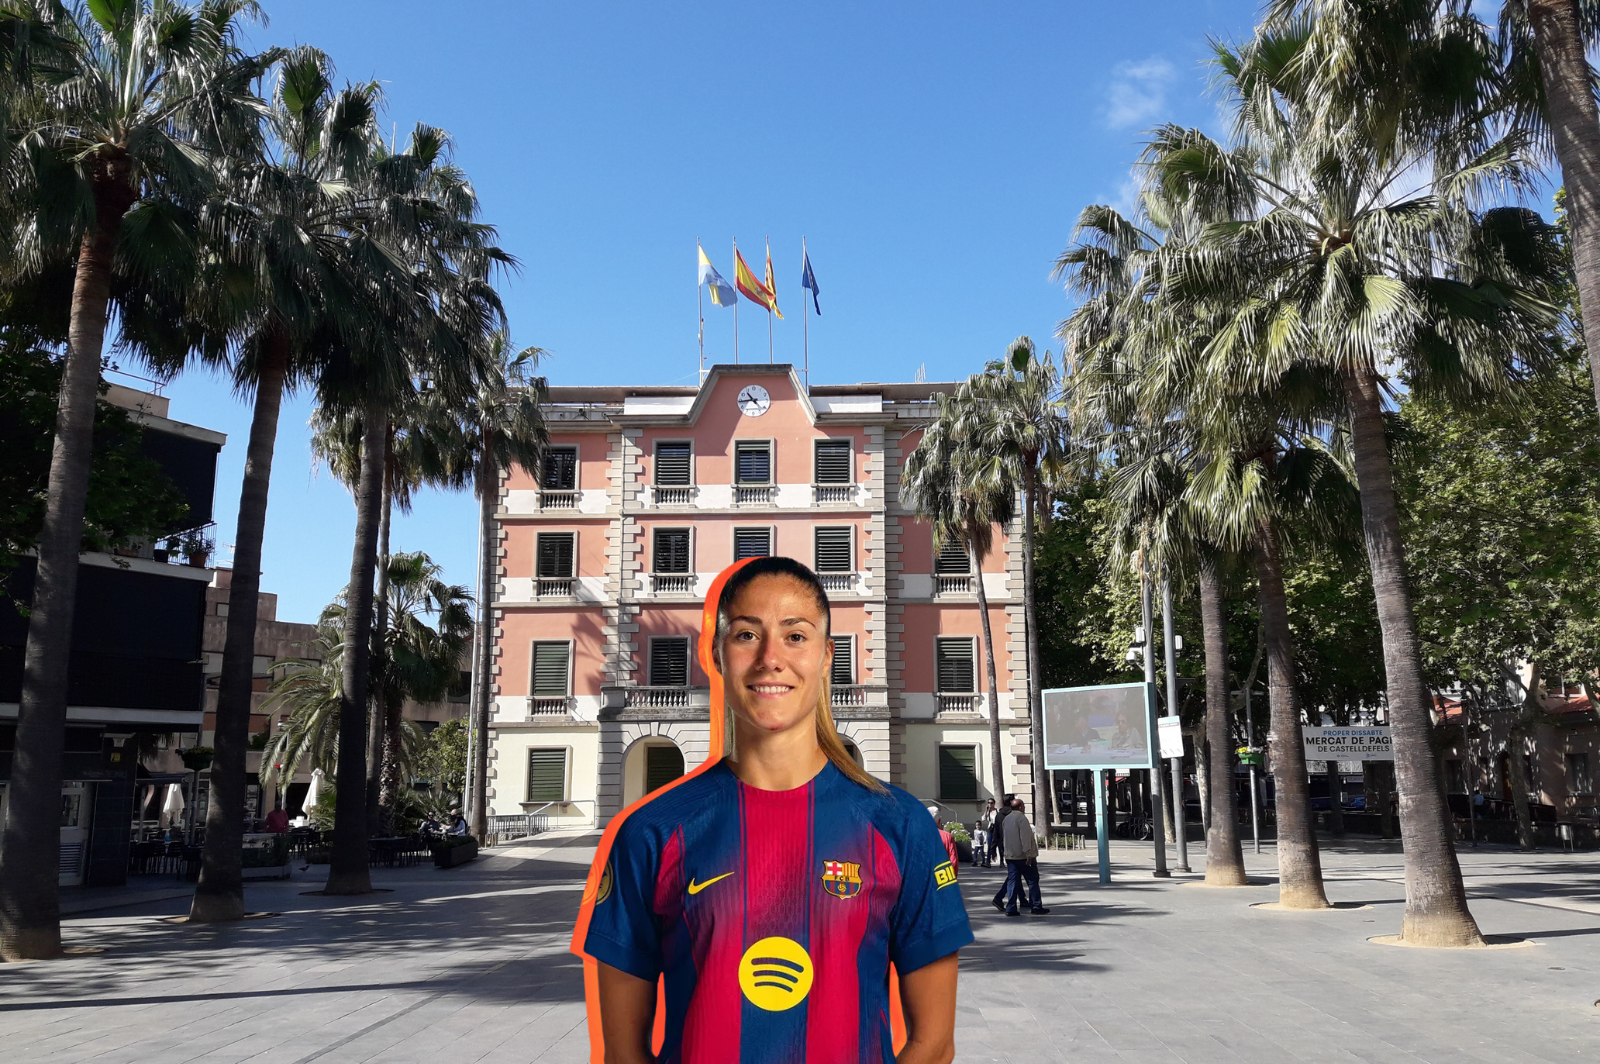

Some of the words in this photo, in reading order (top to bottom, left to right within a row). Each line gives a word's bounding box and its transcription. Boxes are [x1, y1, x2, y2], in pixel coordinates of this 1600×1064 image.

[1306, 737, 1347, 745] MERCAT
[1351, 736, 1364, 744] DE
[1369, 736, 1392, 744] PAG
